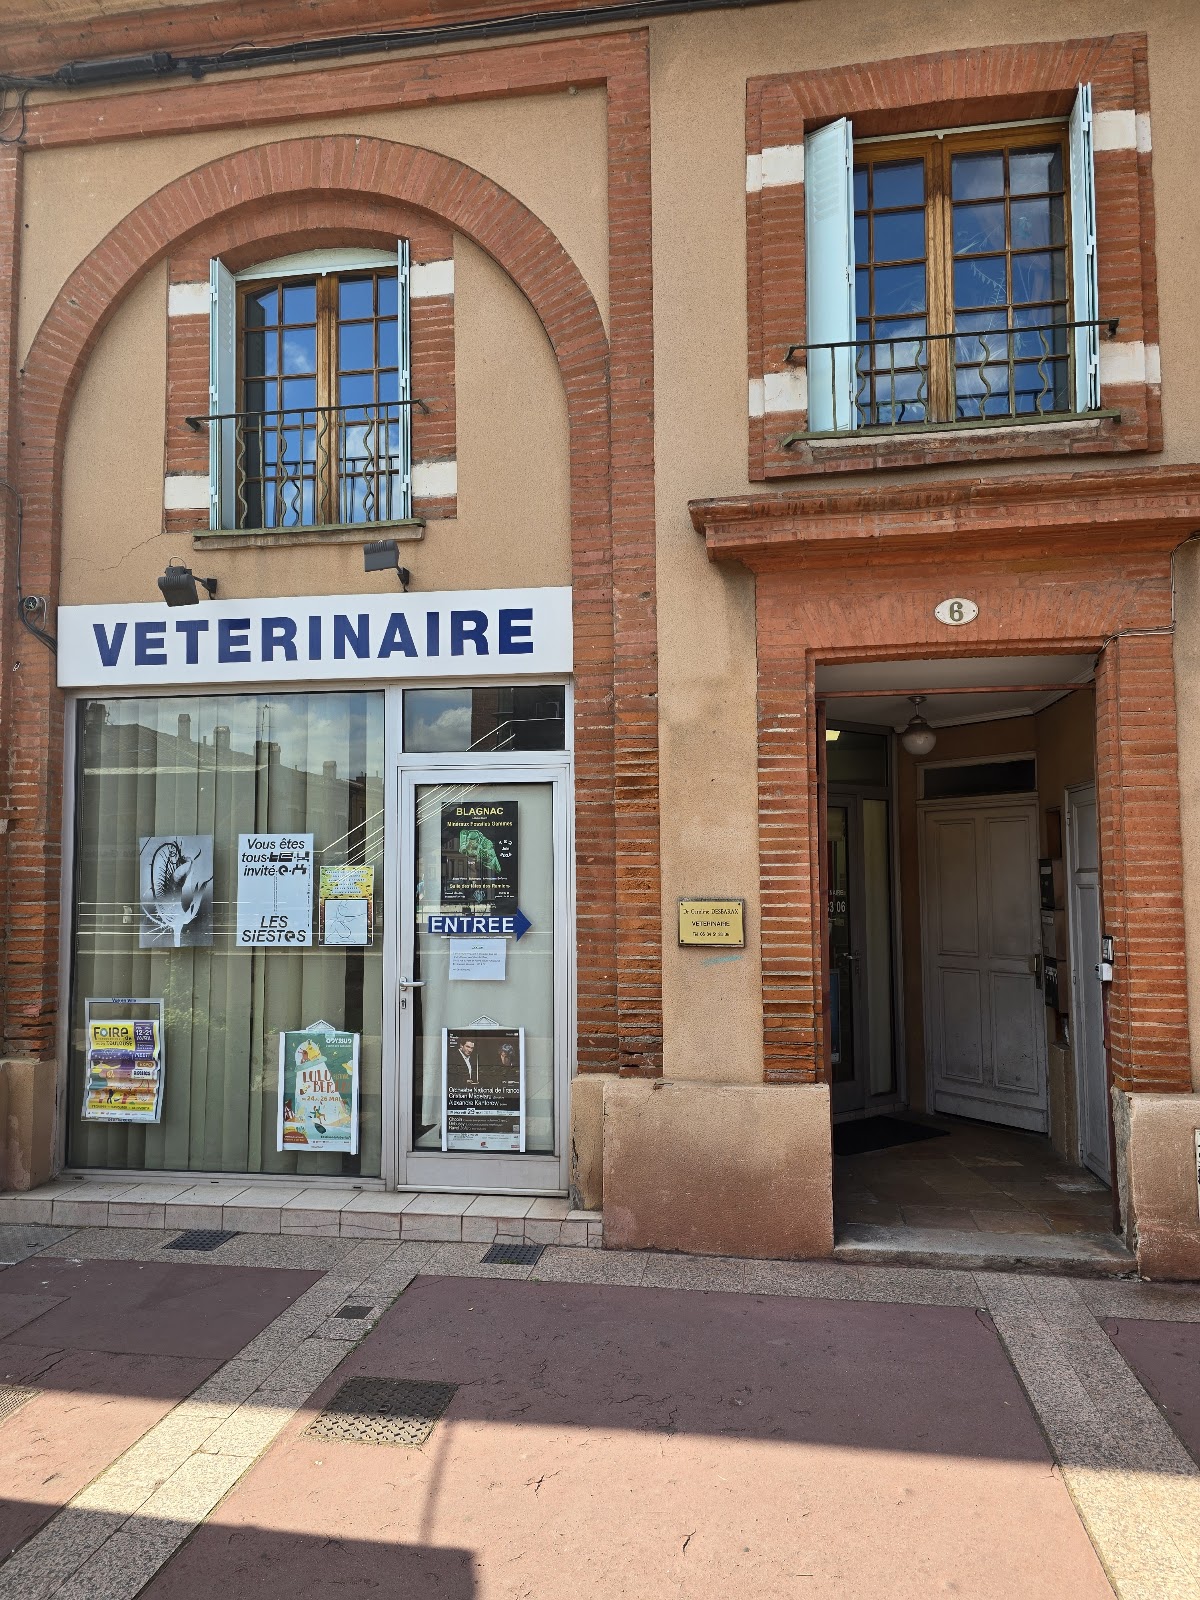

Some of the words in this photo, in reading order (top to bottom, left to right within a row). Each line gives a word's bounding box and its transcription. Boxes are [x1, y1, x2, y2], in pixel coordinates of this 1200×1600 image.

[950, 601, 964, 622] 6
[93, 608, 533, 667] VETERINAIRE
[456, 807, 504, 816] BLAGNAC
[247, 838, 276, 850] Vous
[279, 837, 305, 850] êtes
[837, 901, 846, 913] 06
[260, 915, 289, 928] LES
[431, 917, 514, 933] ENTREE
